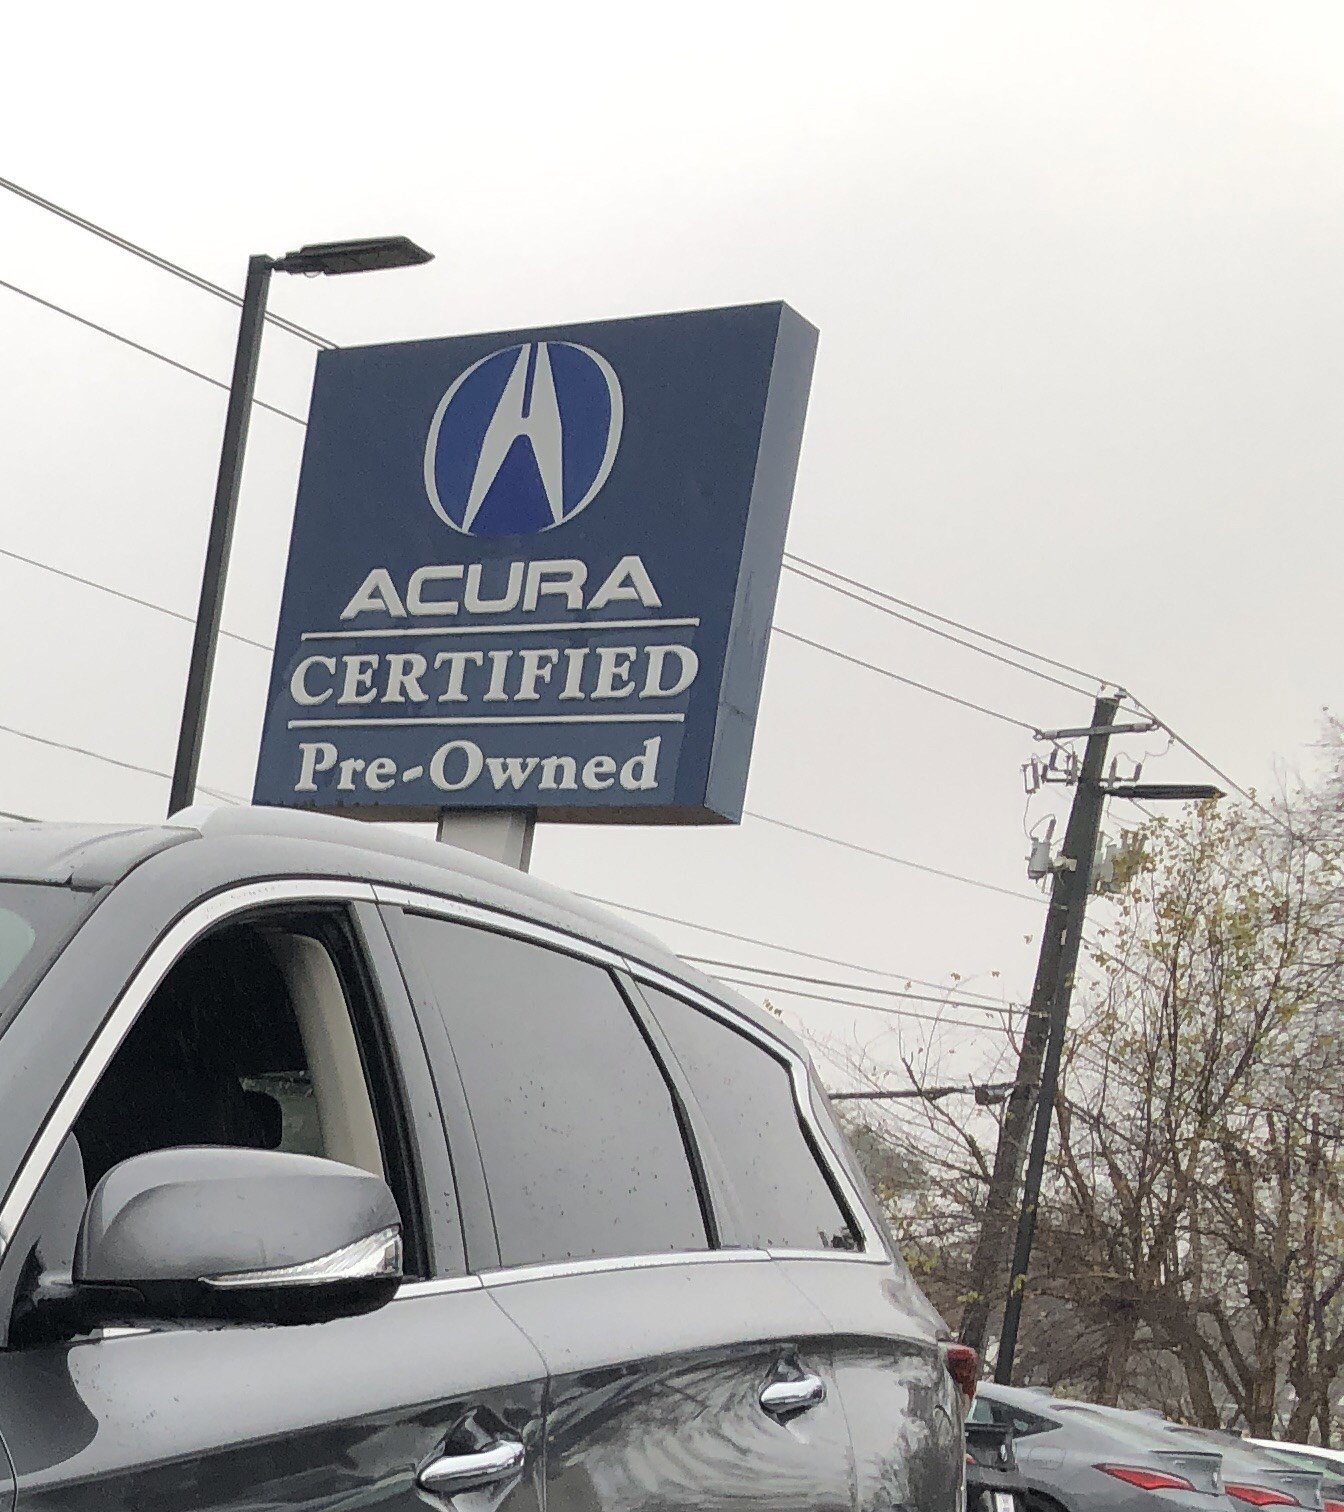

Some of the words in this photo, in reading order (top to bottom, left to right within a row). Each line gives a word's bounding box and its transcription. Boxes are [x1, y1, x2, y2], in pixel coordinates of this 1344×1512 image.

[339, 555, 663, 620] ACURA
[289, 643, 700, 706] CERTIFIED
[293, 736, 662, 792] Pre-Owned
